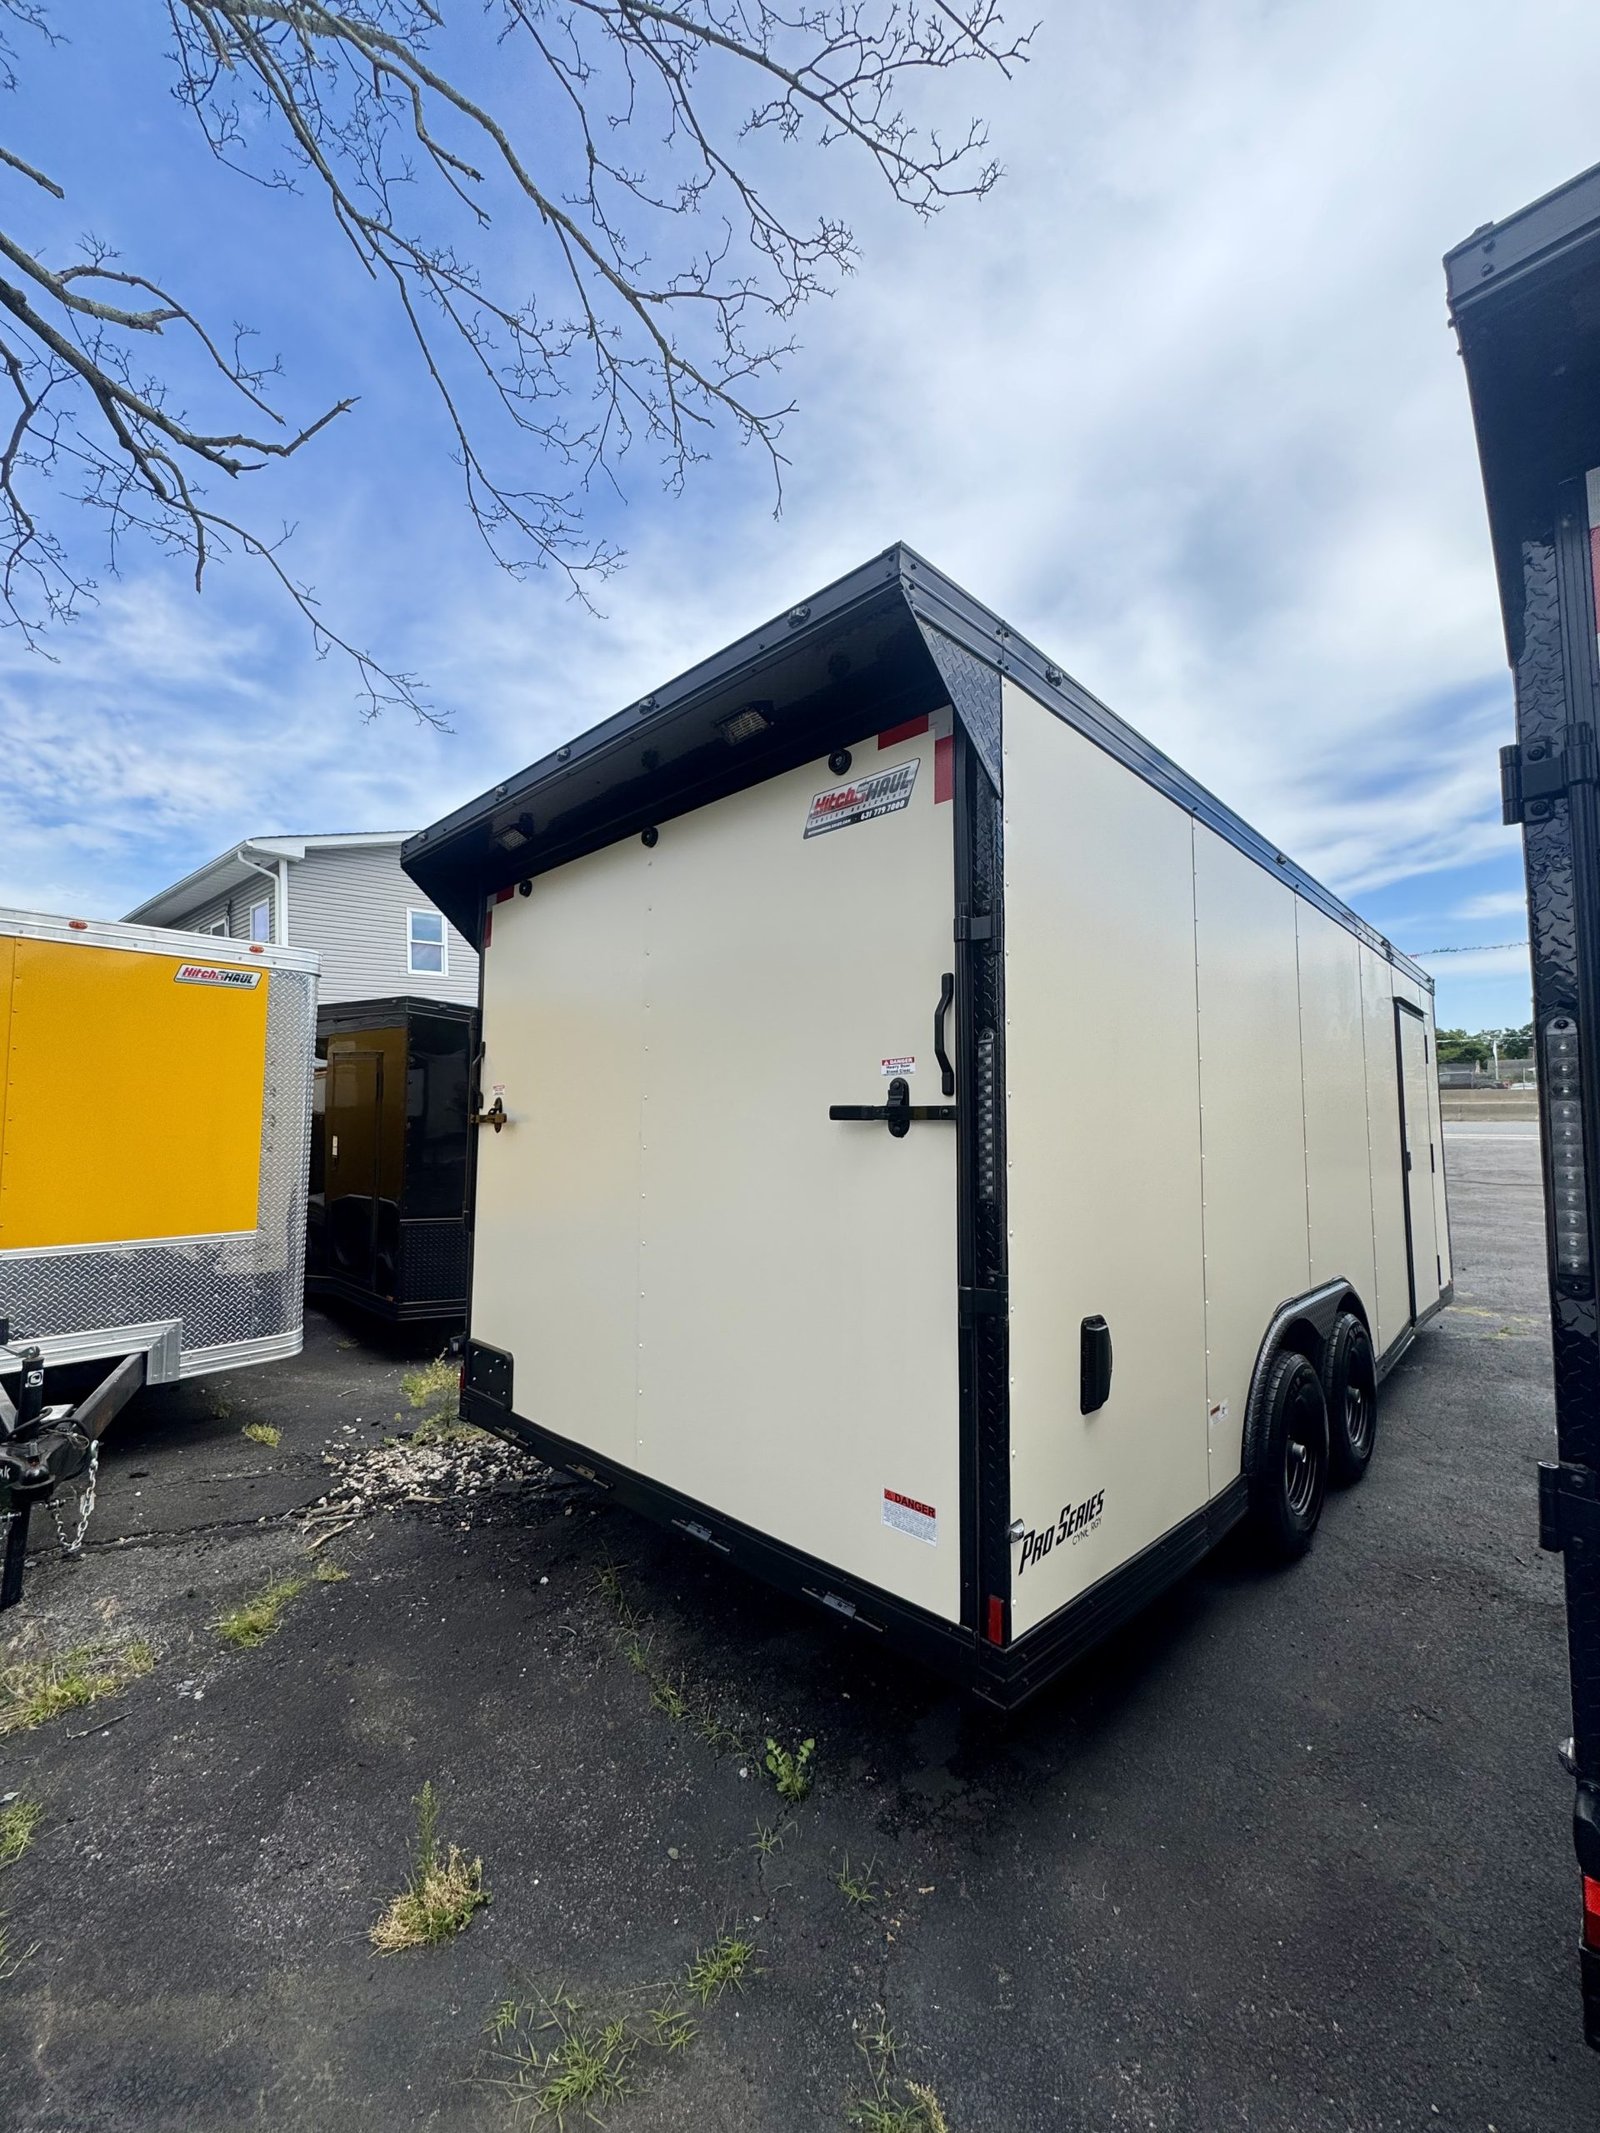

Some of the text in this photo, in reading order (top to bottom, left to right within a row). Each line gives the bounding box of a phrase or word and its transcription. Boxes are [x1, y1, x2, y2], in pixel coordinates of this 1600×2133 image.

[866, 769, 911, 801] HAUL
[183, 966, 254, 984] Hitch HAUL
[895, 1493, 936, 1519] DANGER
[1018, 1487, 1105, 1577] PRO SERIES
